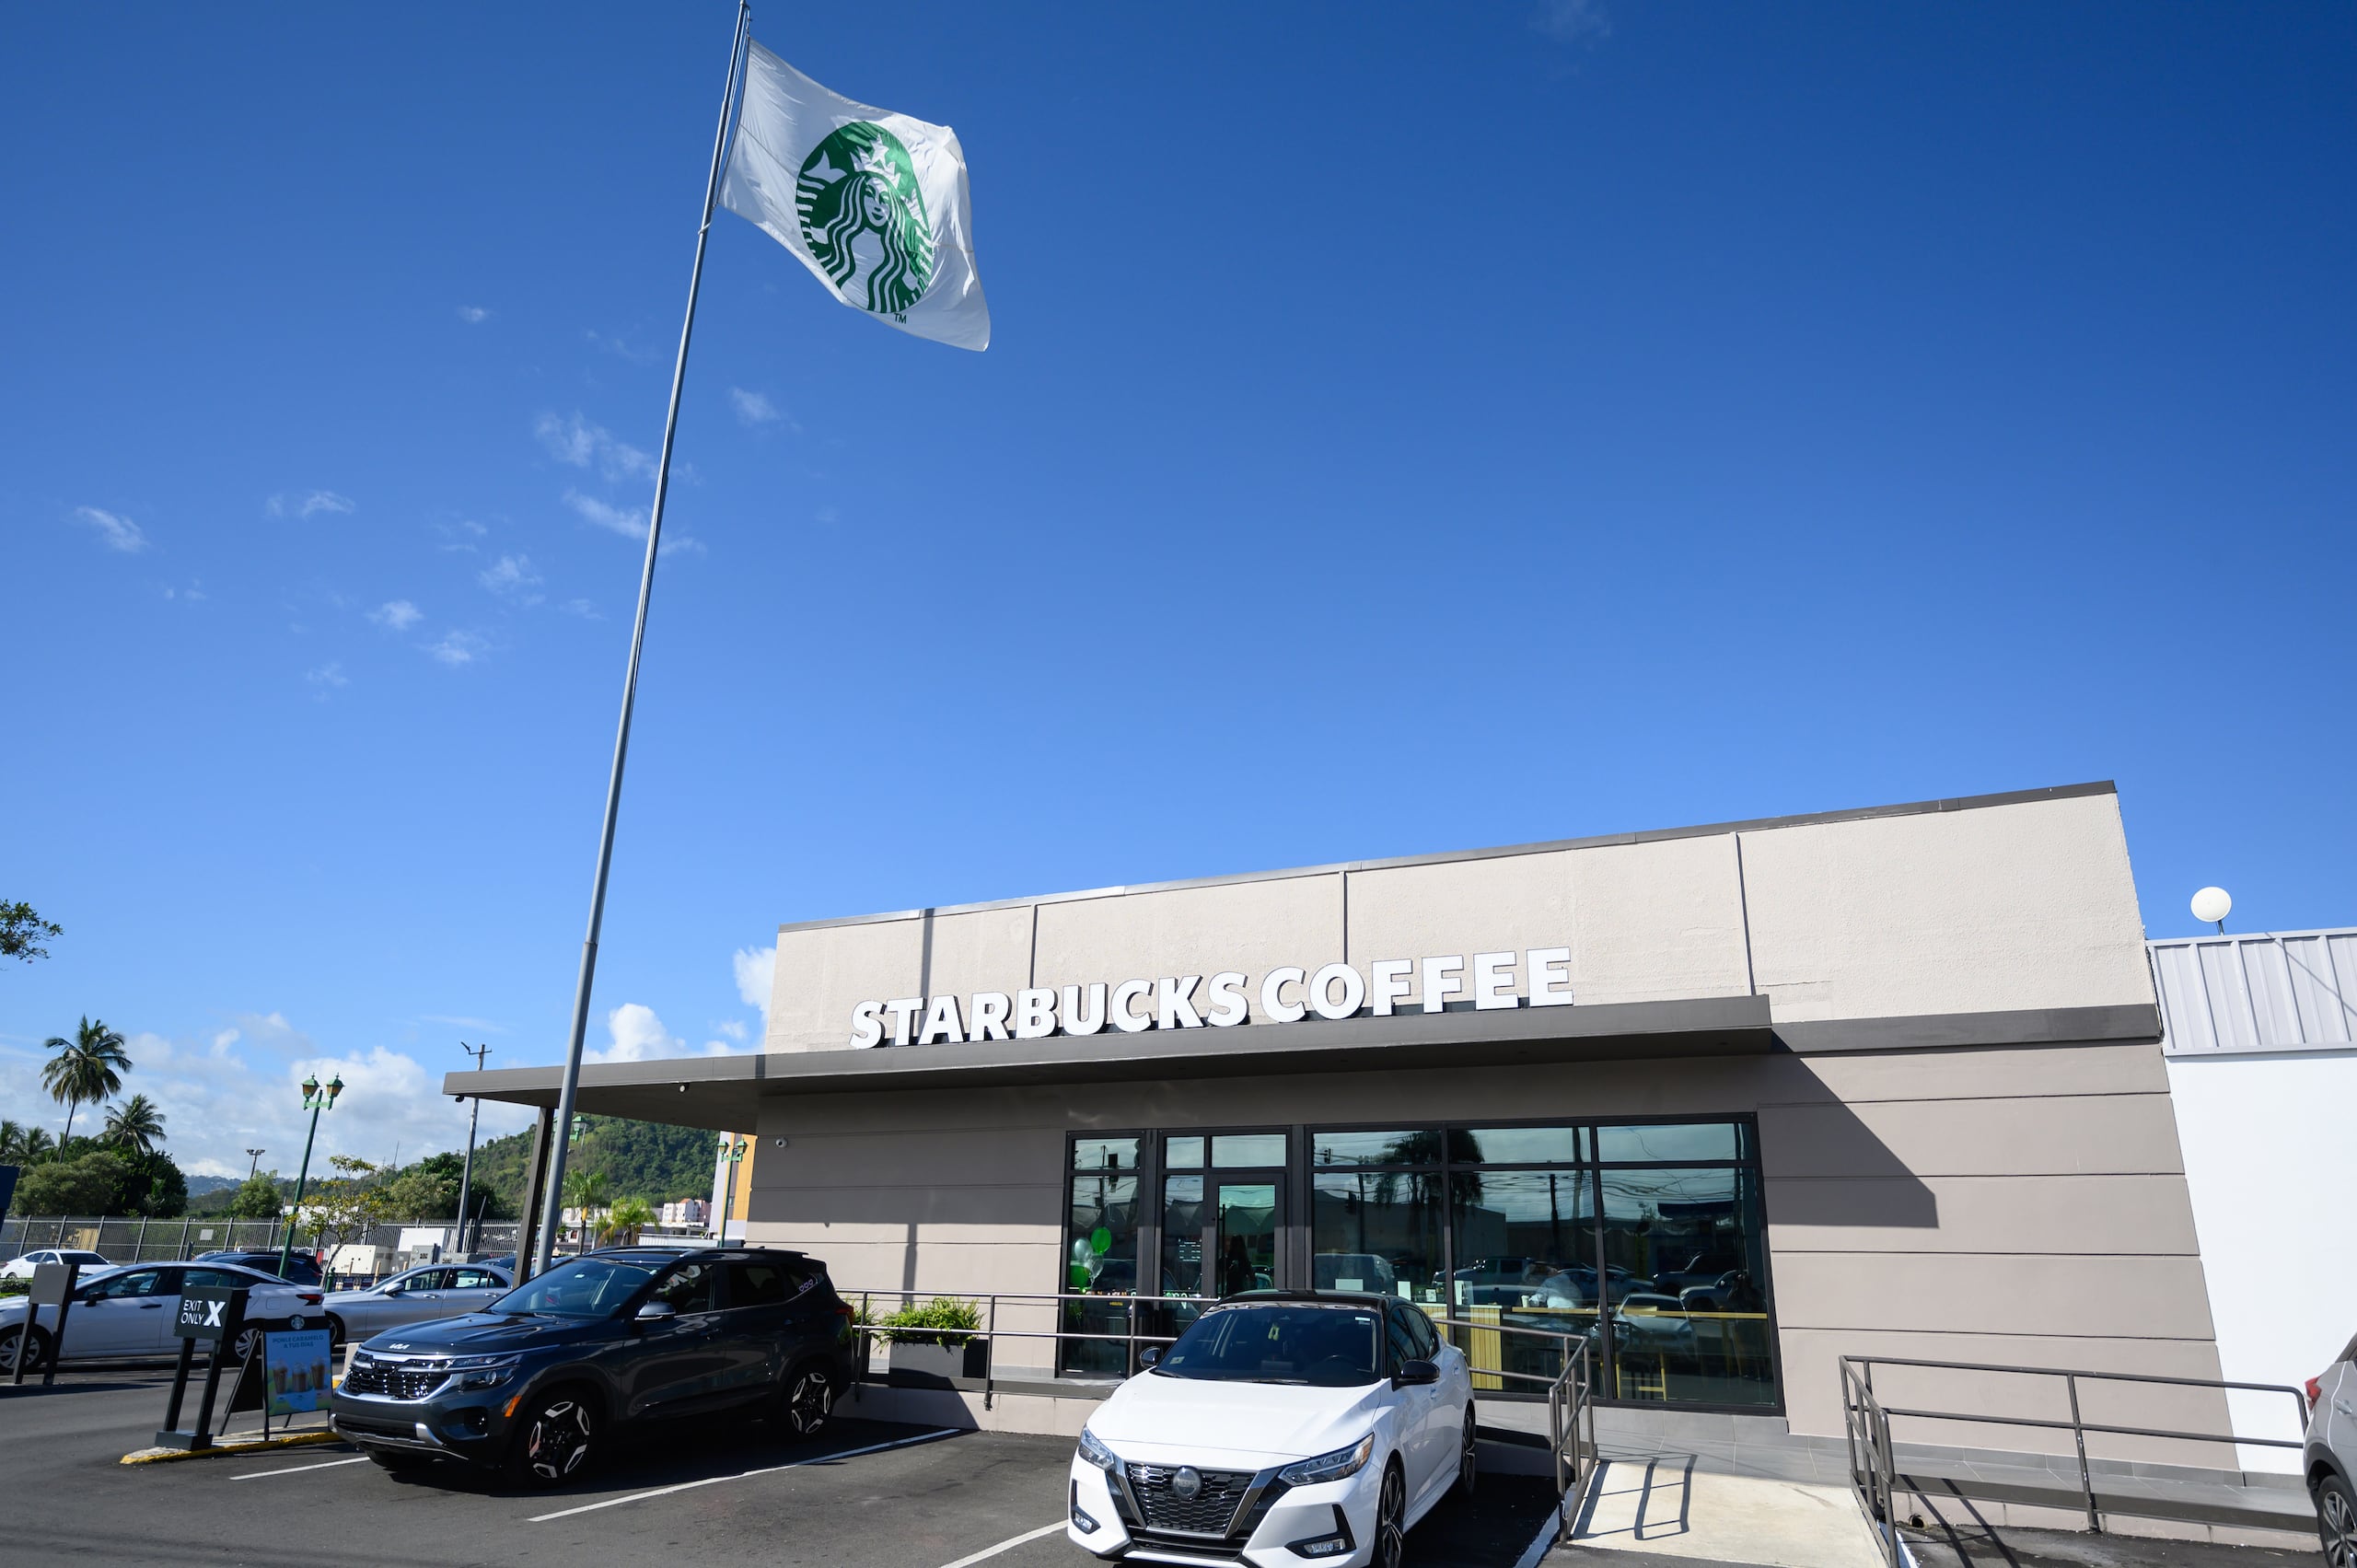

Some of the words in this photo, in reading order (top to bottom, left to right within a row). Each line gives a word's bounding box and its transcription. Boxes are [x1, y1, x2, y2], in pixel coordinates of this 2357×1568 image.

[894, 313, 907, 324] TM
[850, 971, 1249, 1049] STARBUCKS
[1260, 947, 1574, 1022] COFFEE
[183, 1299, 203, 1311] EXIT
[180, 1312, 204, 1325] ONLY
